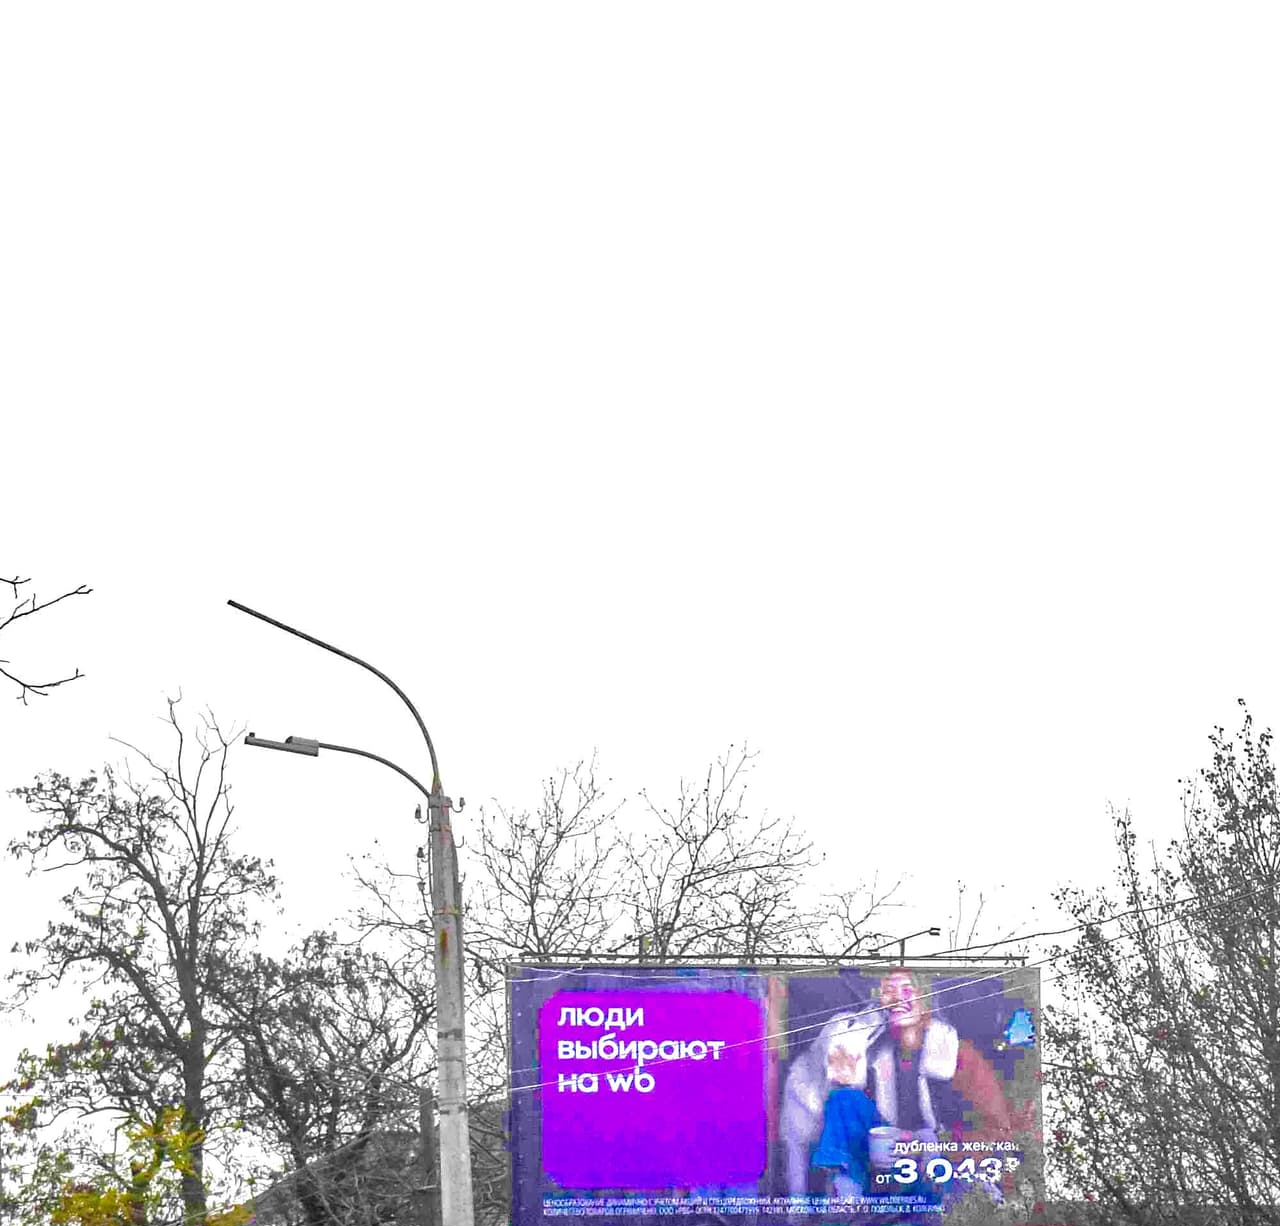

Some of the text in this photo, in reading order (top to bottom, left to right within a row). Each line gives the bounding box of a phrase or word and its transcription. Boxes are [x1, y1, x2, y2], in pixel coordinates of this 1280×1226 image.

[557, 1007, 644, 1031] люди
[557, 1033, 725, 1066] выбирают
[558, 1066, 656, 1093] на wb
[893, 1140, 958, 1154] дубленка
[876, 1174, 891, 1184] от
